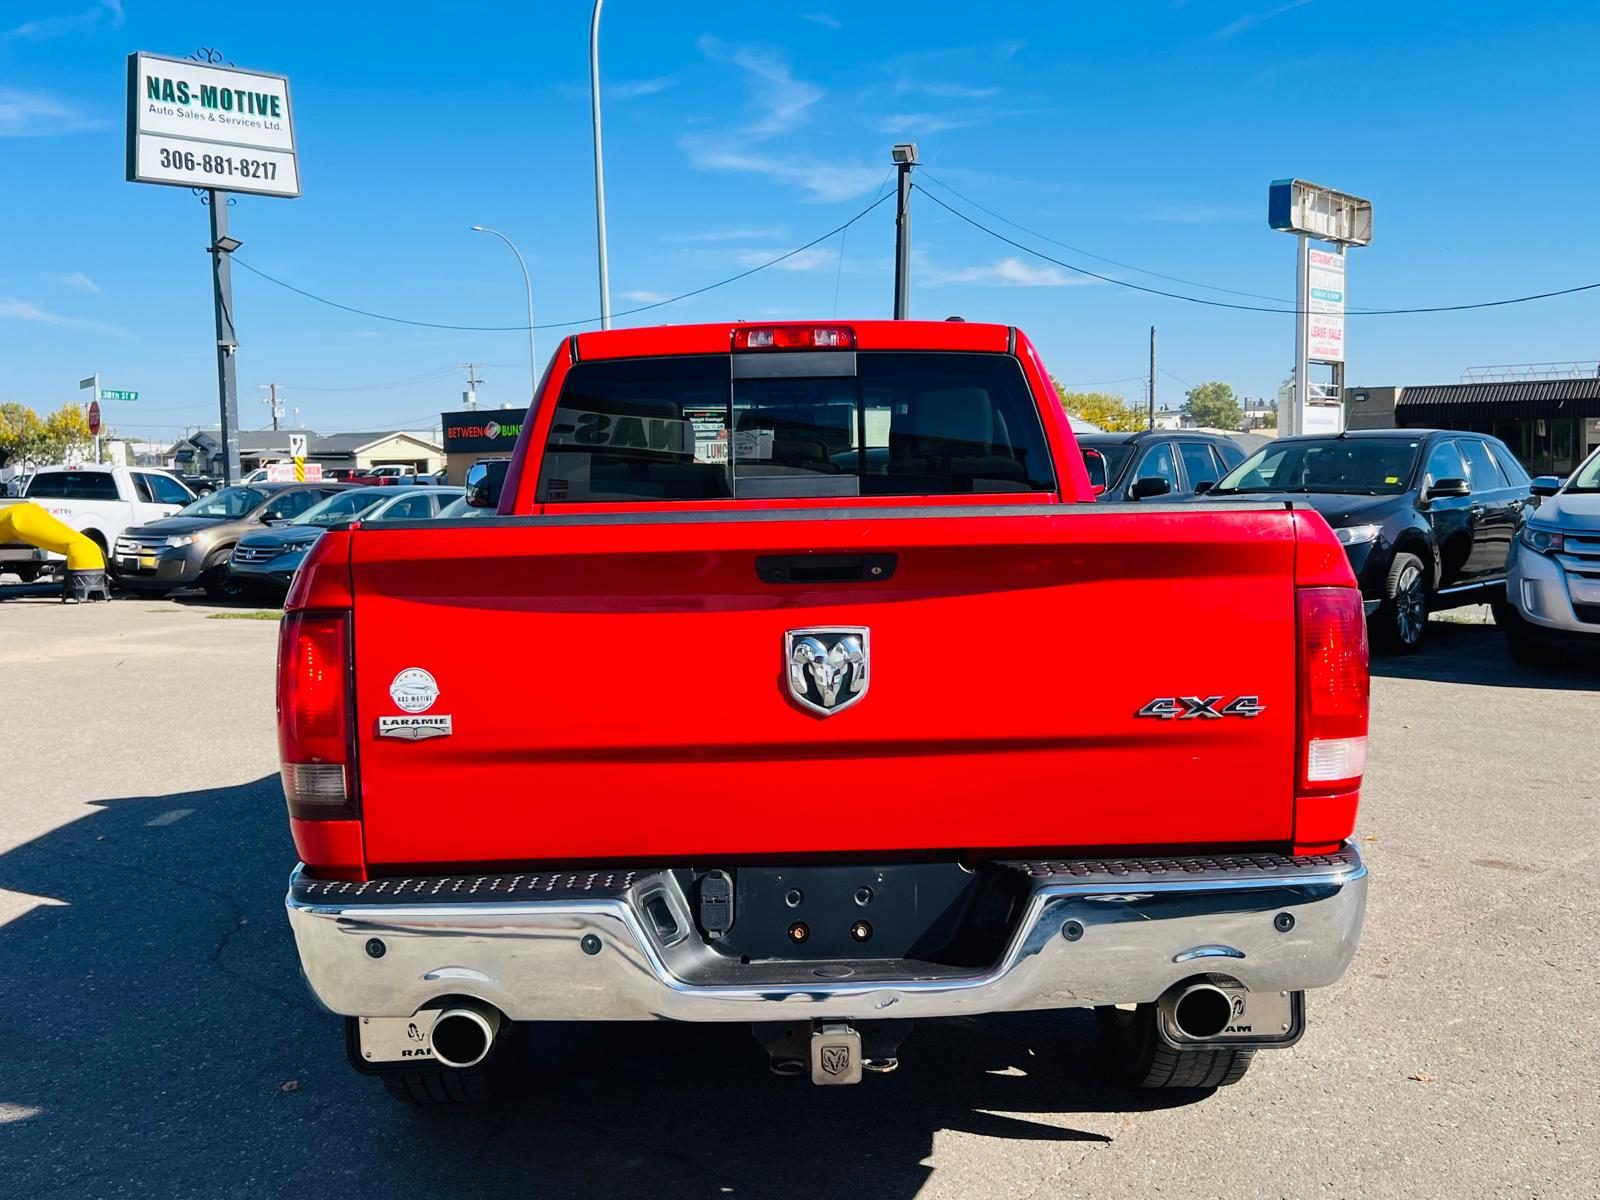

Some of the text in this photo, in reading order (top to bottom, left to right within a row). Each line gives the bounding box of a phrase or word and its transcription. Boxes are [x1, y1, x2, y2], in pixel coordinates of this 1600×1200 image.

[146, 75, 281, 118] NAS-MOTIVE
[148, 103, 283, 131] Auto Sales & Services Ltd.
[160, 148, 277, 180] 306-881-8217
[447, 426, 483, 438] BETWEEN
[706, 443, 728, 459] LUNC
[382, 718, 448, 726] LARAMIE
[1224, 1025, 1252, 1033] AM
